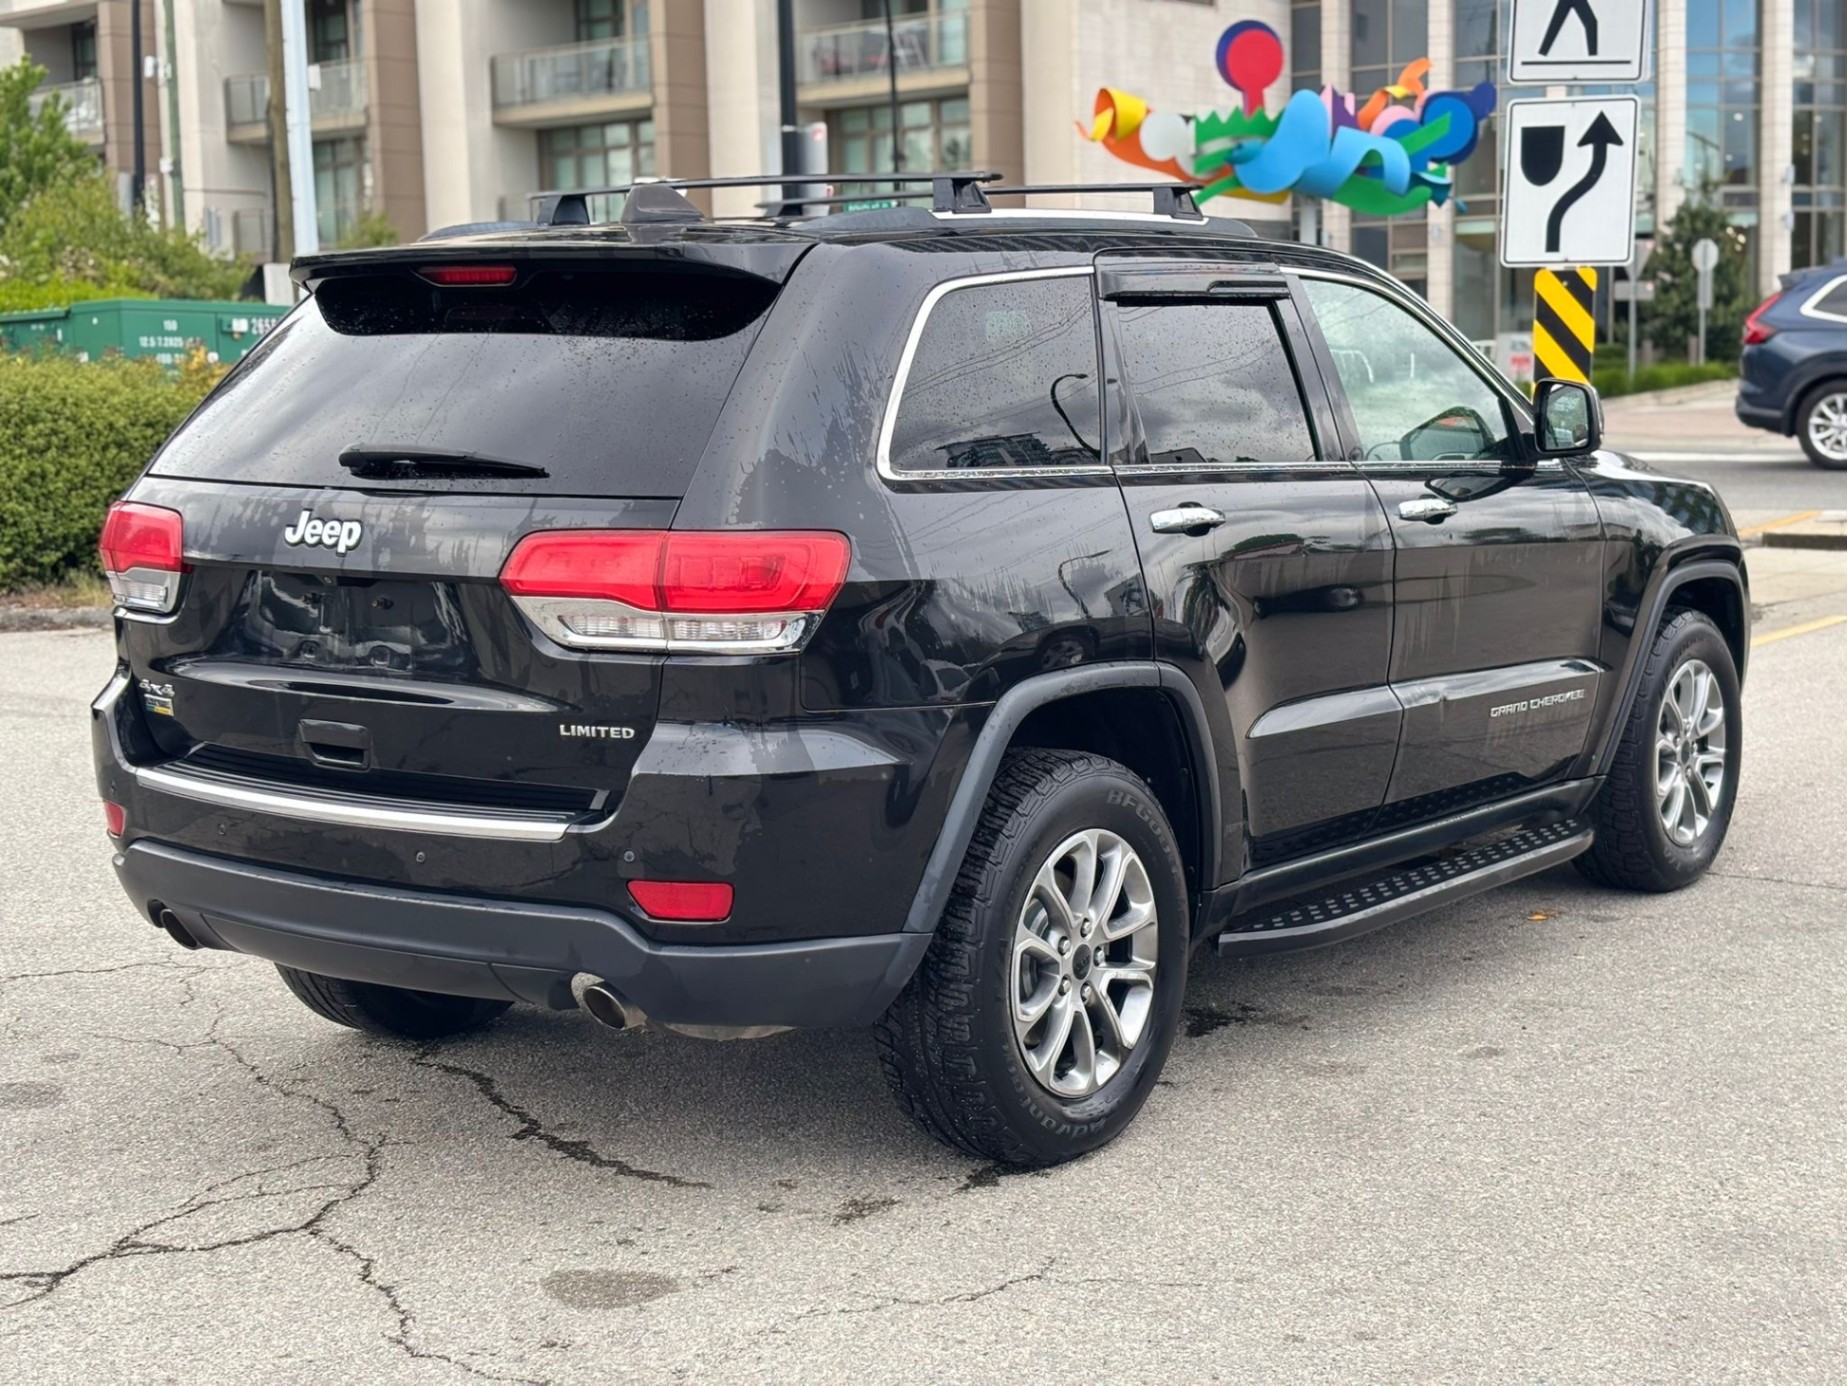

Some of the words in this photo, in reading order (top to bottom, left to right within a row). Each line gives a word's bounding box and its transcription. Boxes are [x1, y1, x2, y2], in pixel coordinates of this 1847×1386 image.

[284, 509, 362, 556] Jeep
[1490, 701, 1528, 718] GRAND
[1529, 689, 1585, 710] CHEROKEE
[559, 724, 635, 739] LIMITED
